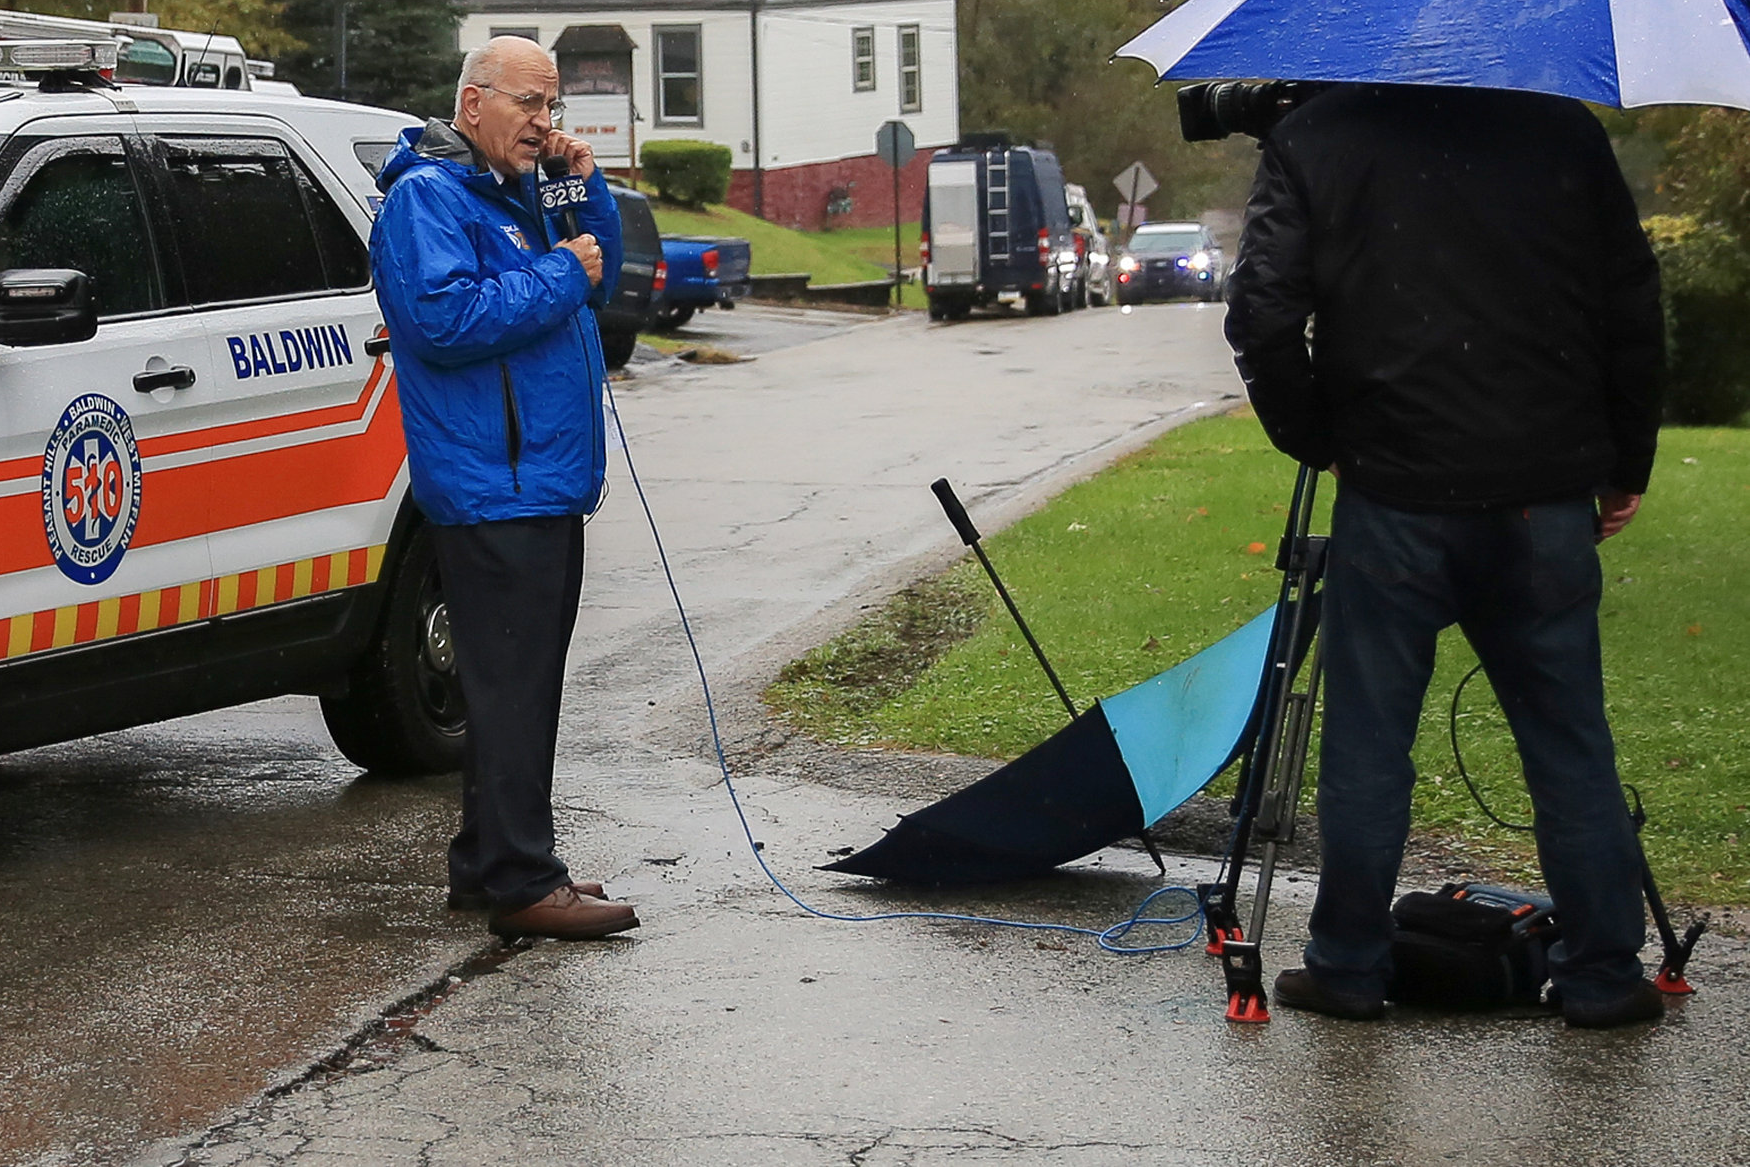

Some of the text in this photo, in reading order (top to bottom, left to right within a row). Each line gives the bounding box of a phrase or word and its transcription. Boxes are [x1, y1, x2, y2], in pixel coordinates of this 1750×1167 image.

[540, 181, 565, 193] KDKA
[566, 178, 584, 187] KDKA
[227, 324, 353, 380] BALDWIN
[68, 397, 116, 420] BALDWIN
[62, 414, 120, 451] PARAMEDIC
[43, 427, 64, 561] PLEASANT HILLS
[65, 461, 123, 524] 510
[119, 414, 141, 549] WEST MIFFLIN
[70, 539, 114, 565] RESCUE
